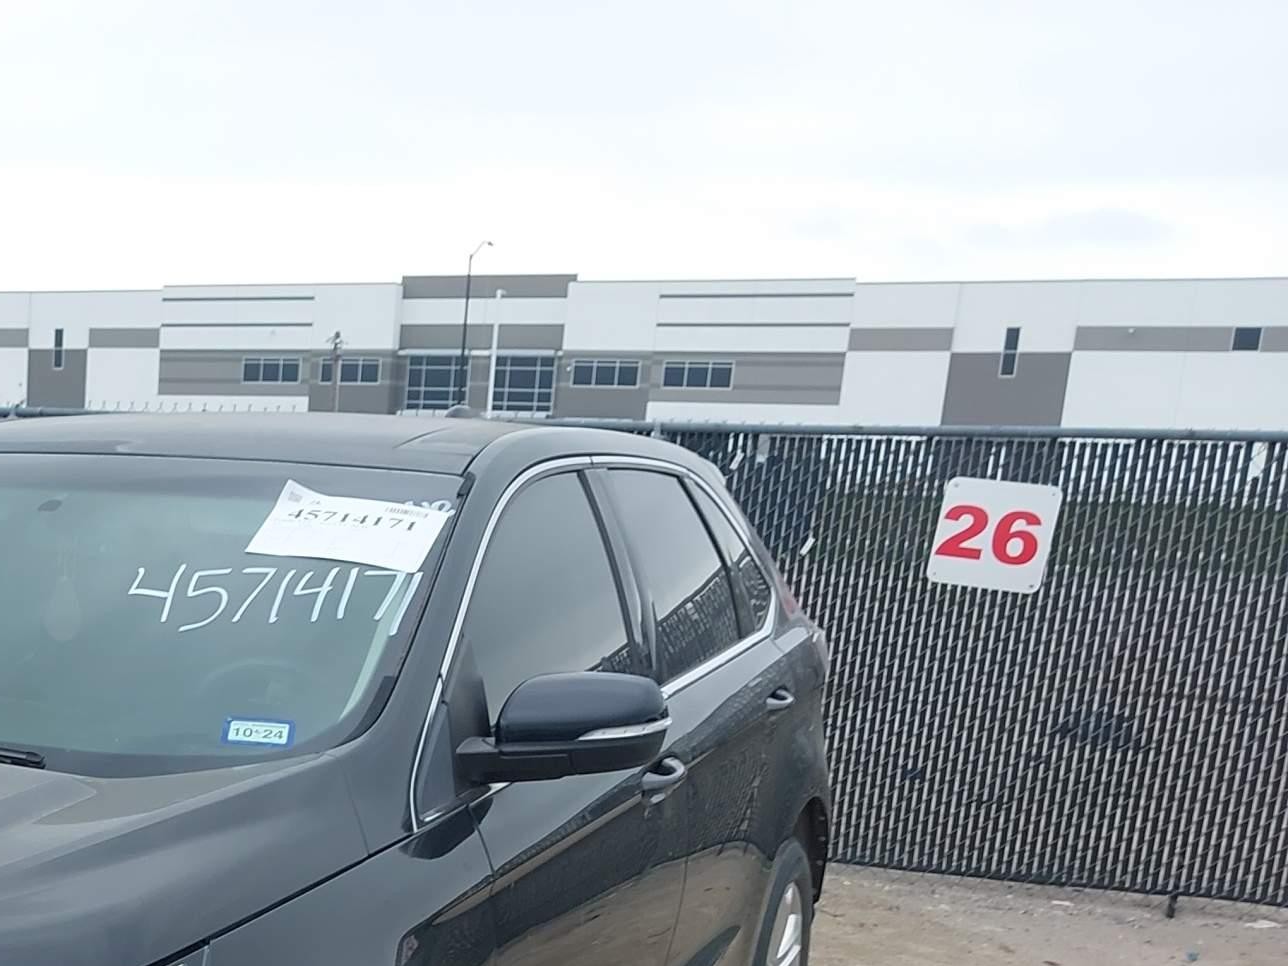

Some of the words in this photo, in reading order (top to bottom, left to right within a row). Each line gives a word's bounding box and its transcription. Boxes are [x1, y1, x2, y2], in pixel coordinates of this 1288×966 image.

[288, 508, 416, 531] 45714171
[935, 505, 1041, 565] 26
[128, 563, 423, 636] 45714171
